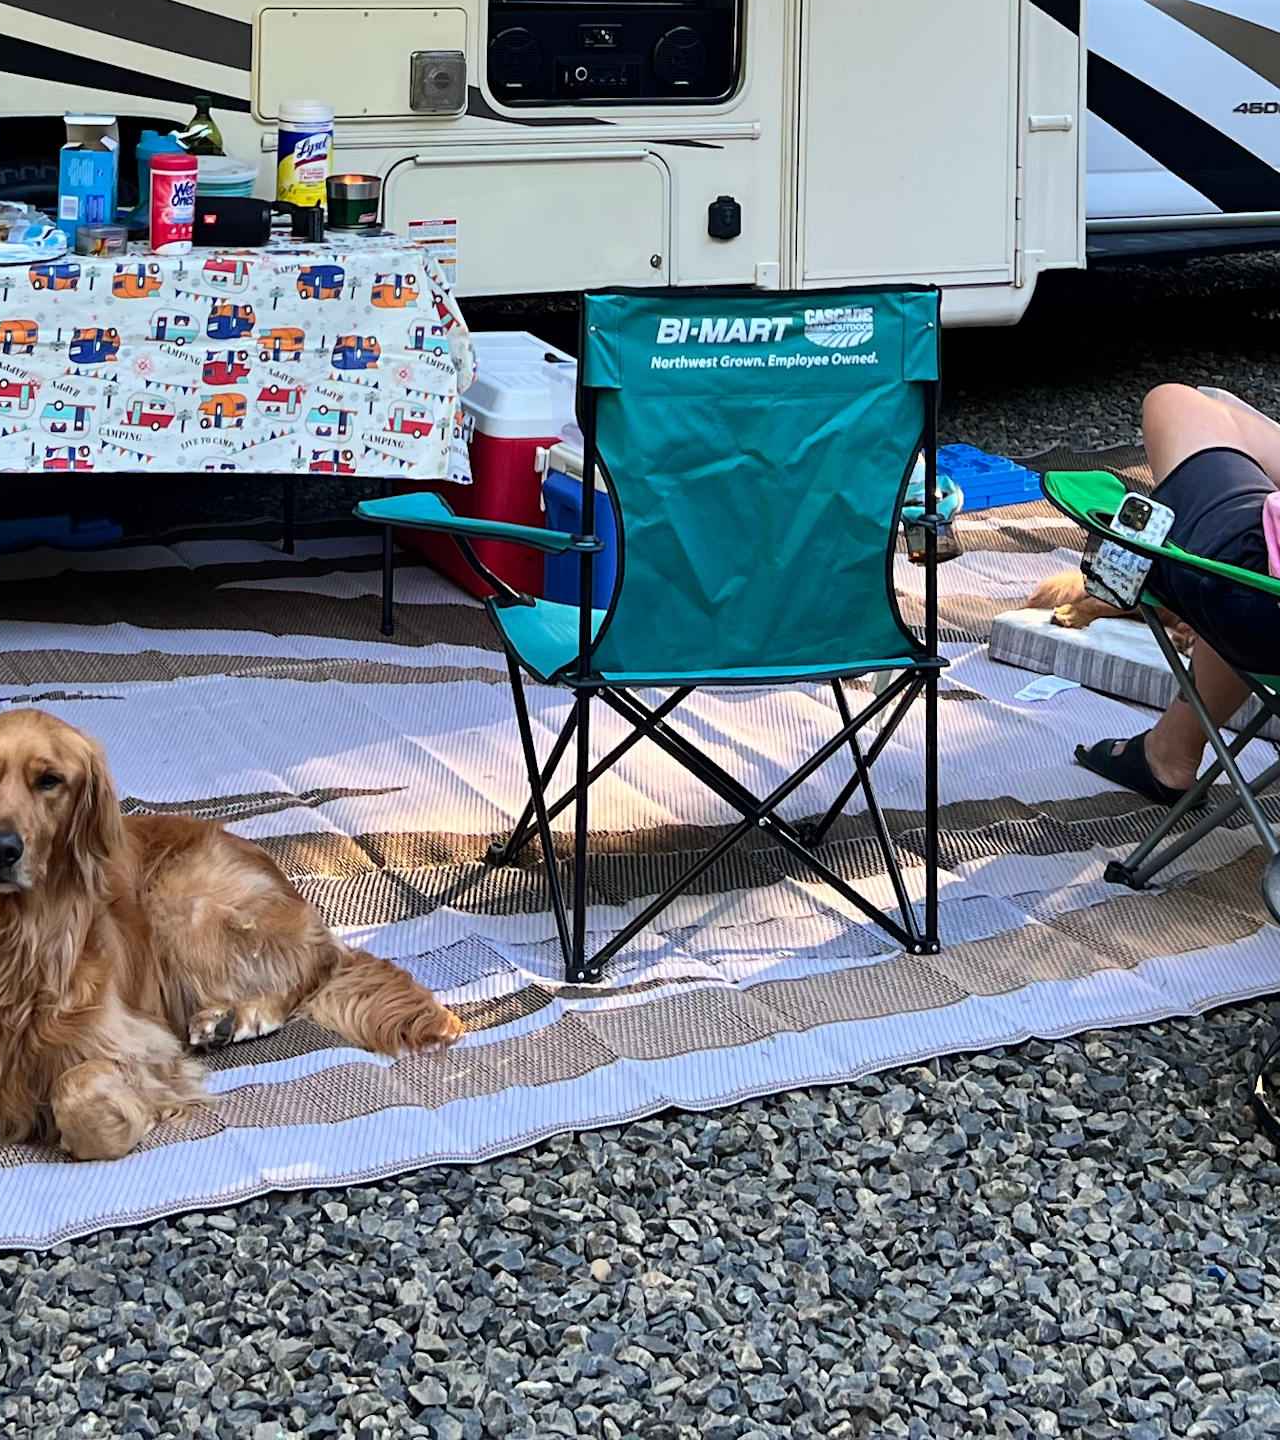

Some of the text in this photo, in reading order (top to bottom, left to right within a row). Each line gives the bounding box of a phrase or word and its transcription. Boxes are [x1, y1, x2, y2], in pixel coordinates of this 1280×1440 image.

[297, 136, 328, 159] Lysol
[174, 181, 195, 197] Wet
[171, 194, 194, 207] Ones
[804, 307, 873, 325] CASCADE
[833, 323, 873, 332] OUTDOOR
[158, 343, 202, 366] CAMPING
[651, 351, 879, 369] Northwest Grown. Employee Owned.
[418, 354, 455, 376] CAMPING
[269, 368, 296, 385] HAPPY
[51, 380, 81, 398] HAPPY
[315, 386, 344, 403] HAPPY
[98, 426, 143, 443] CAMPING
[361, 431, 405, 450] CAMPING
[181, 437, 199, 450] LIVE
